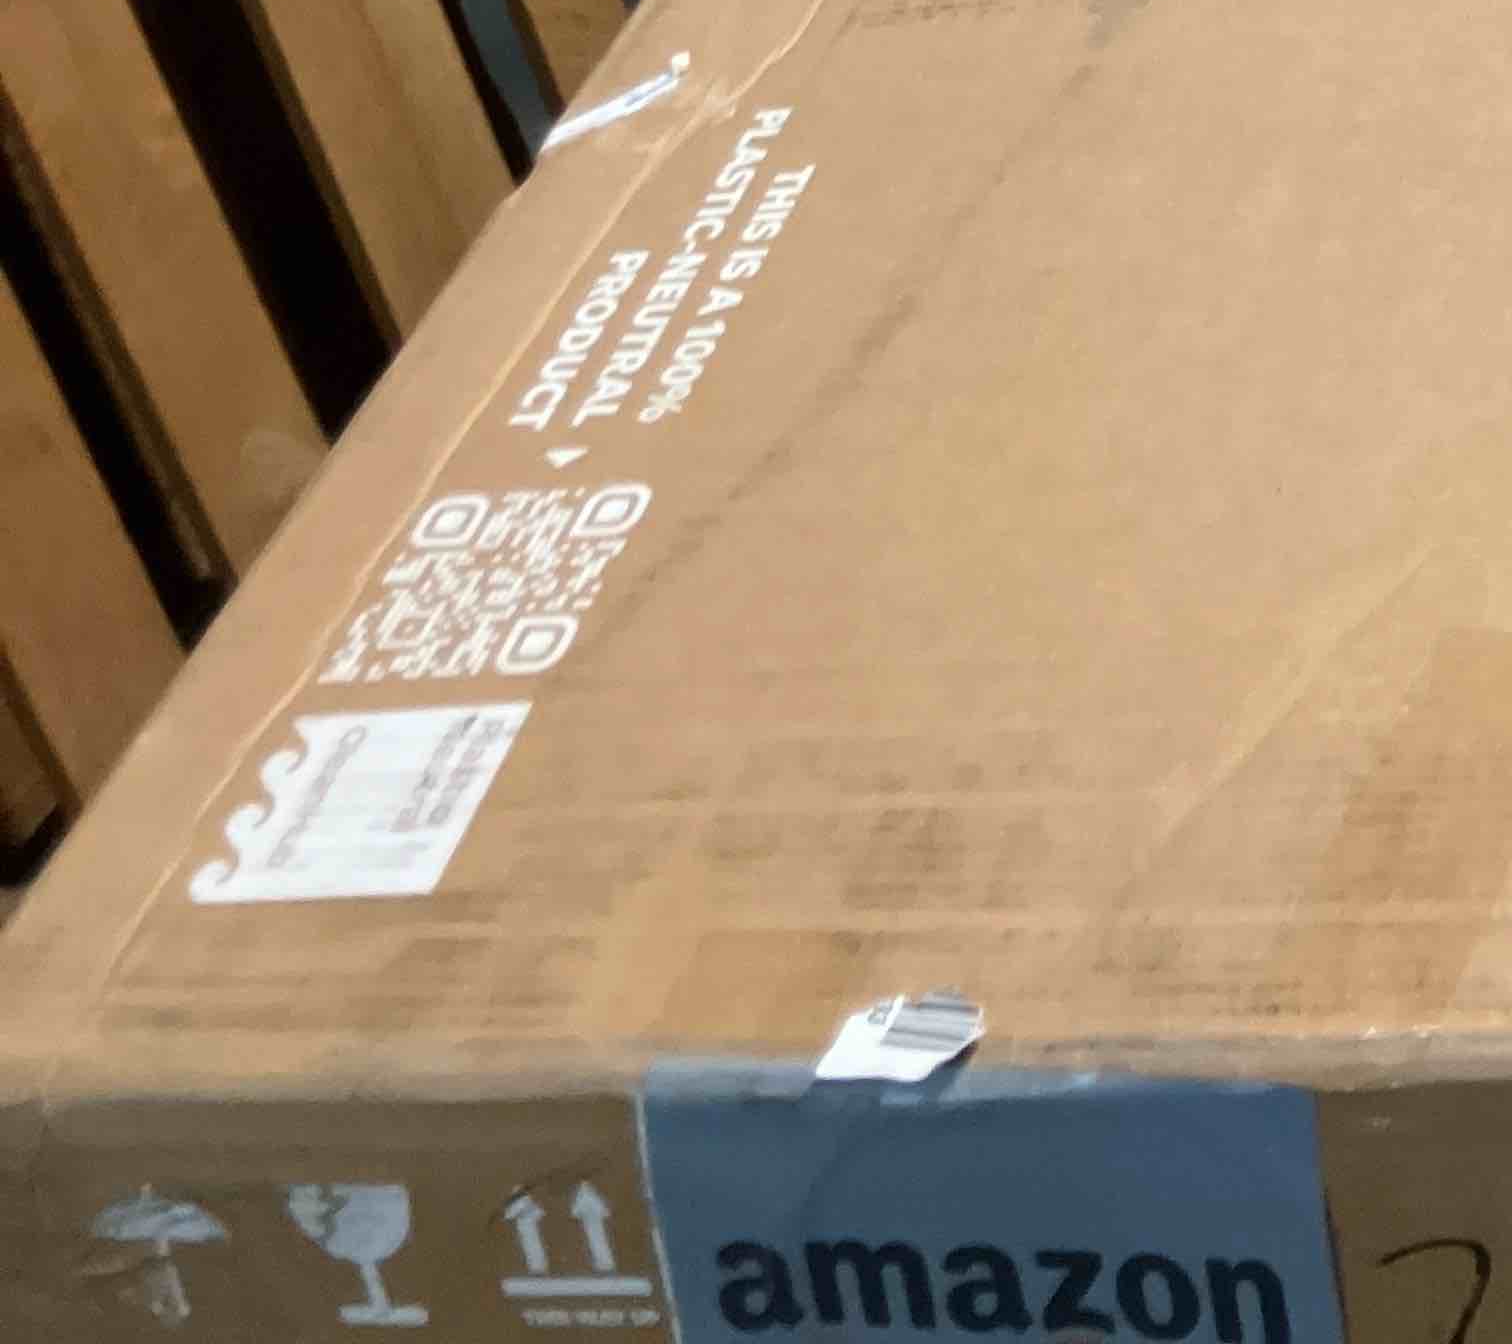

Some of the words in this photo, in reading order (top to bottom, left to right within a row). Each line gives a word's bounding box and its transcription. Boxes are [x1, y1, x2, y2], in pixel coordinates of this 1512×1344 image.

[741, 162, 817, 243] THIS
[569, 105, 796, 429] PLASTIC-NEUTRAL
[698, 285, 744, 317] A
[718, 247, 771, 283] IS
[507, 248, 652, 433] PRODUCT
[637, 319, 727, 425] 100%
[715, 1235, 1293, 1344] amazon
